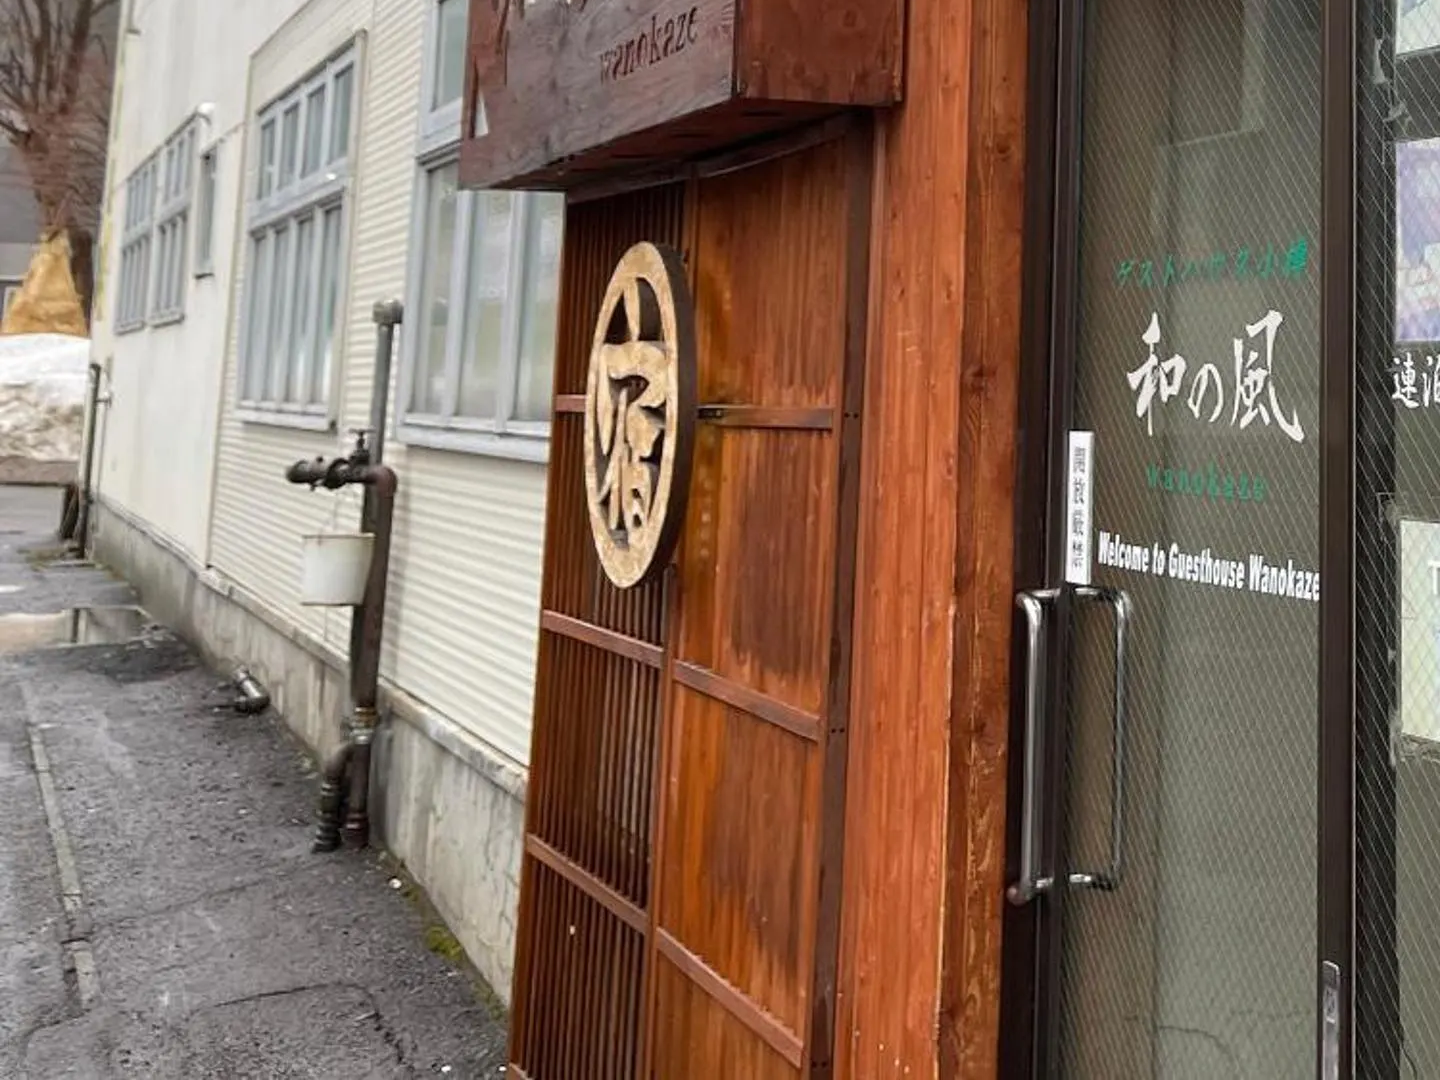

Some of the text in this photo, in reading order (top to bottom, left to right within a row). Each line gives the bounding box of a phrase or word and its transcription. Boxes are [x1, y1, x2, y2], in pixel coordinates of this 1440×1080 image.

[599, 6, 698, 84] wanokaze
[1126, 308, 1306, 444] 和の風
[1098, 529, 1321, 603] Welcome to Guesthouse Wanokaze
